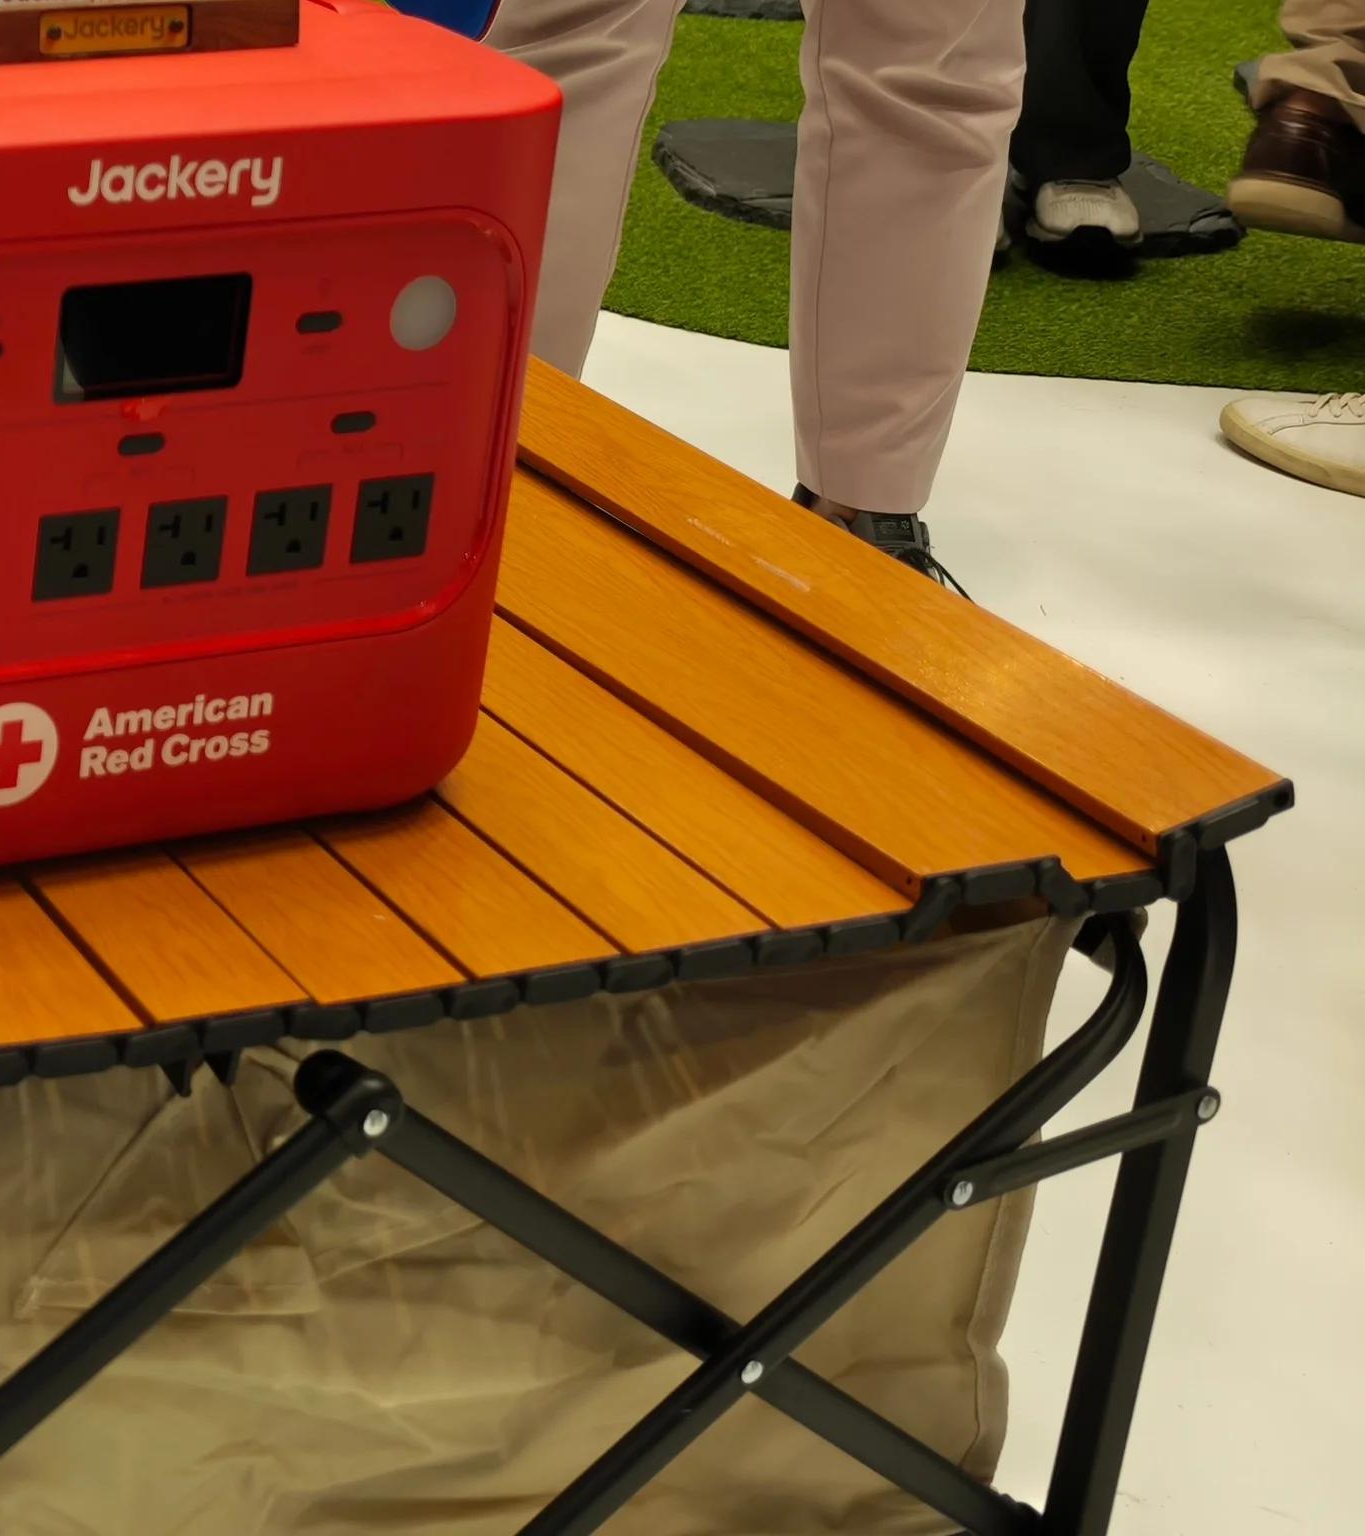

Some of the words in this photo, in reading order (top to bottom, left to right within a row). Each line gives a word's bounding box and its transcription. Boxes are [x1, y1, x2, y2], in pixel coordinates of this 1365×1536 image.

[63, 16, 165, 40] Jackery
[68, 155, 283, 207] Jackery
[83, 692, 273, 741] American
[79, 738, 154, 779] Red
[161, 729, 270, 766] Cross
